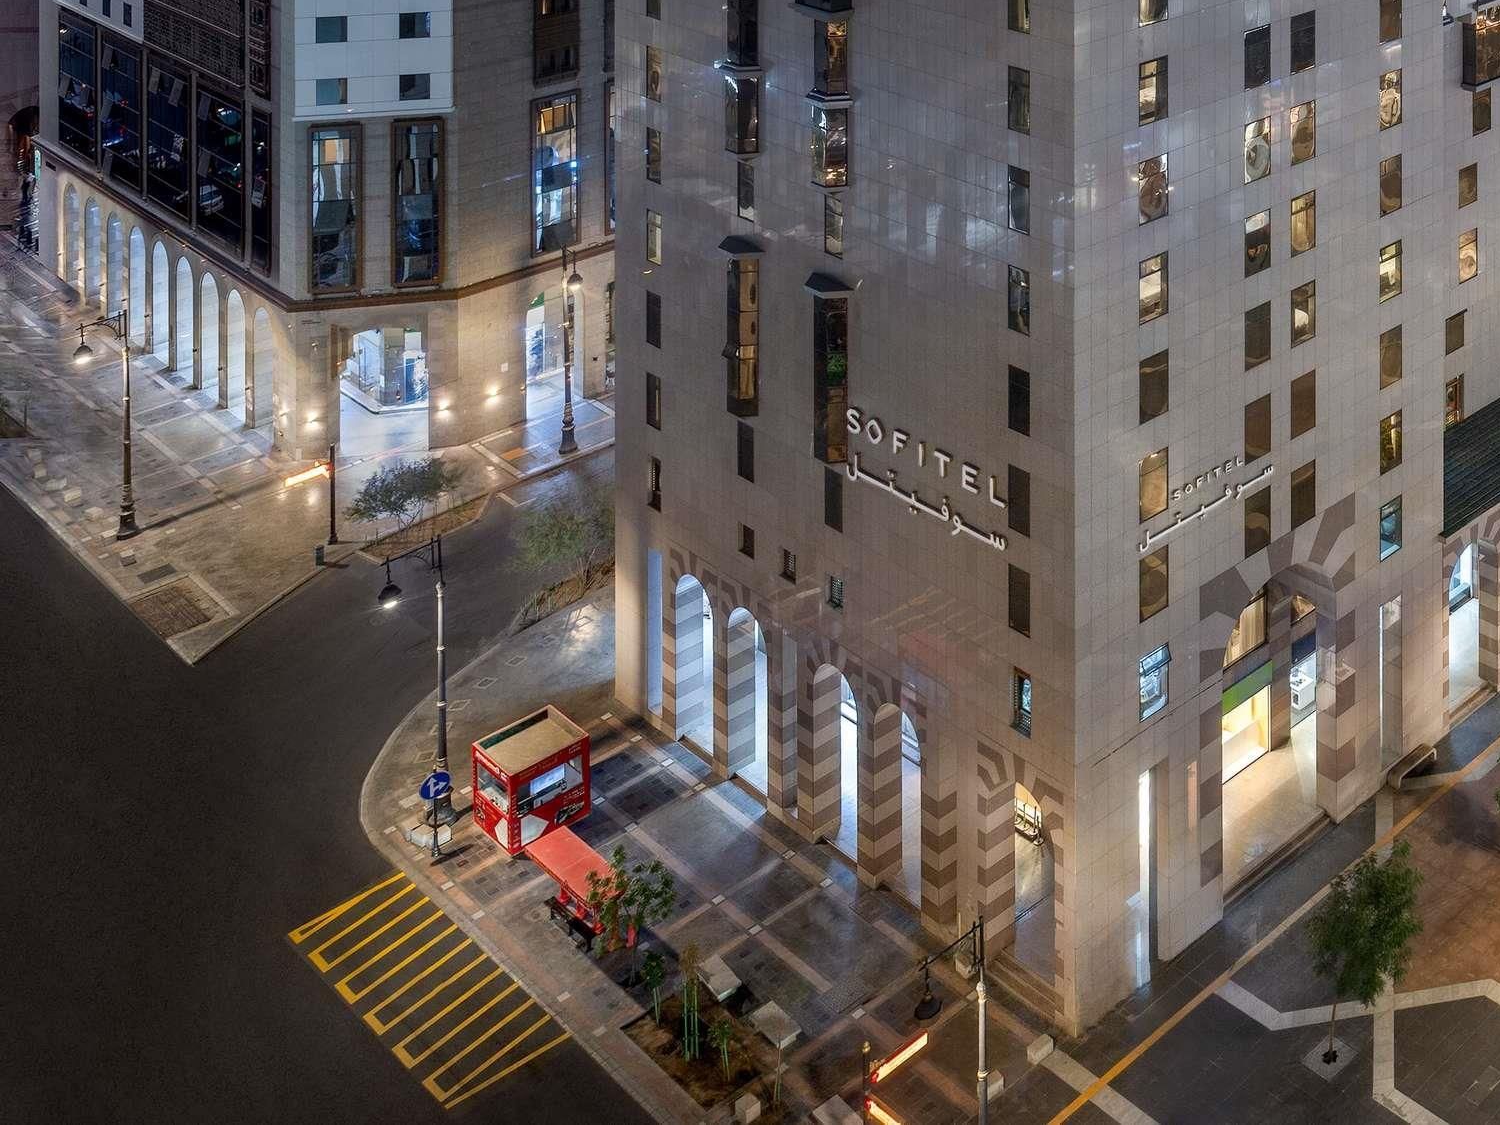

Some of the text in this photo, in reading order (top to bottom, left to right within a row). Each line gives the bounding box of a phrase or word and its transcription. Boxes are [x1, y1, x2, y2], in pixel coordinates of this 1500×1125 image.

[846, 408, 1007, 509] SOFITEL
[846, 453, 1006, 551] سوفيتل
[1173, 456, 1244, 501] SOFITEL
